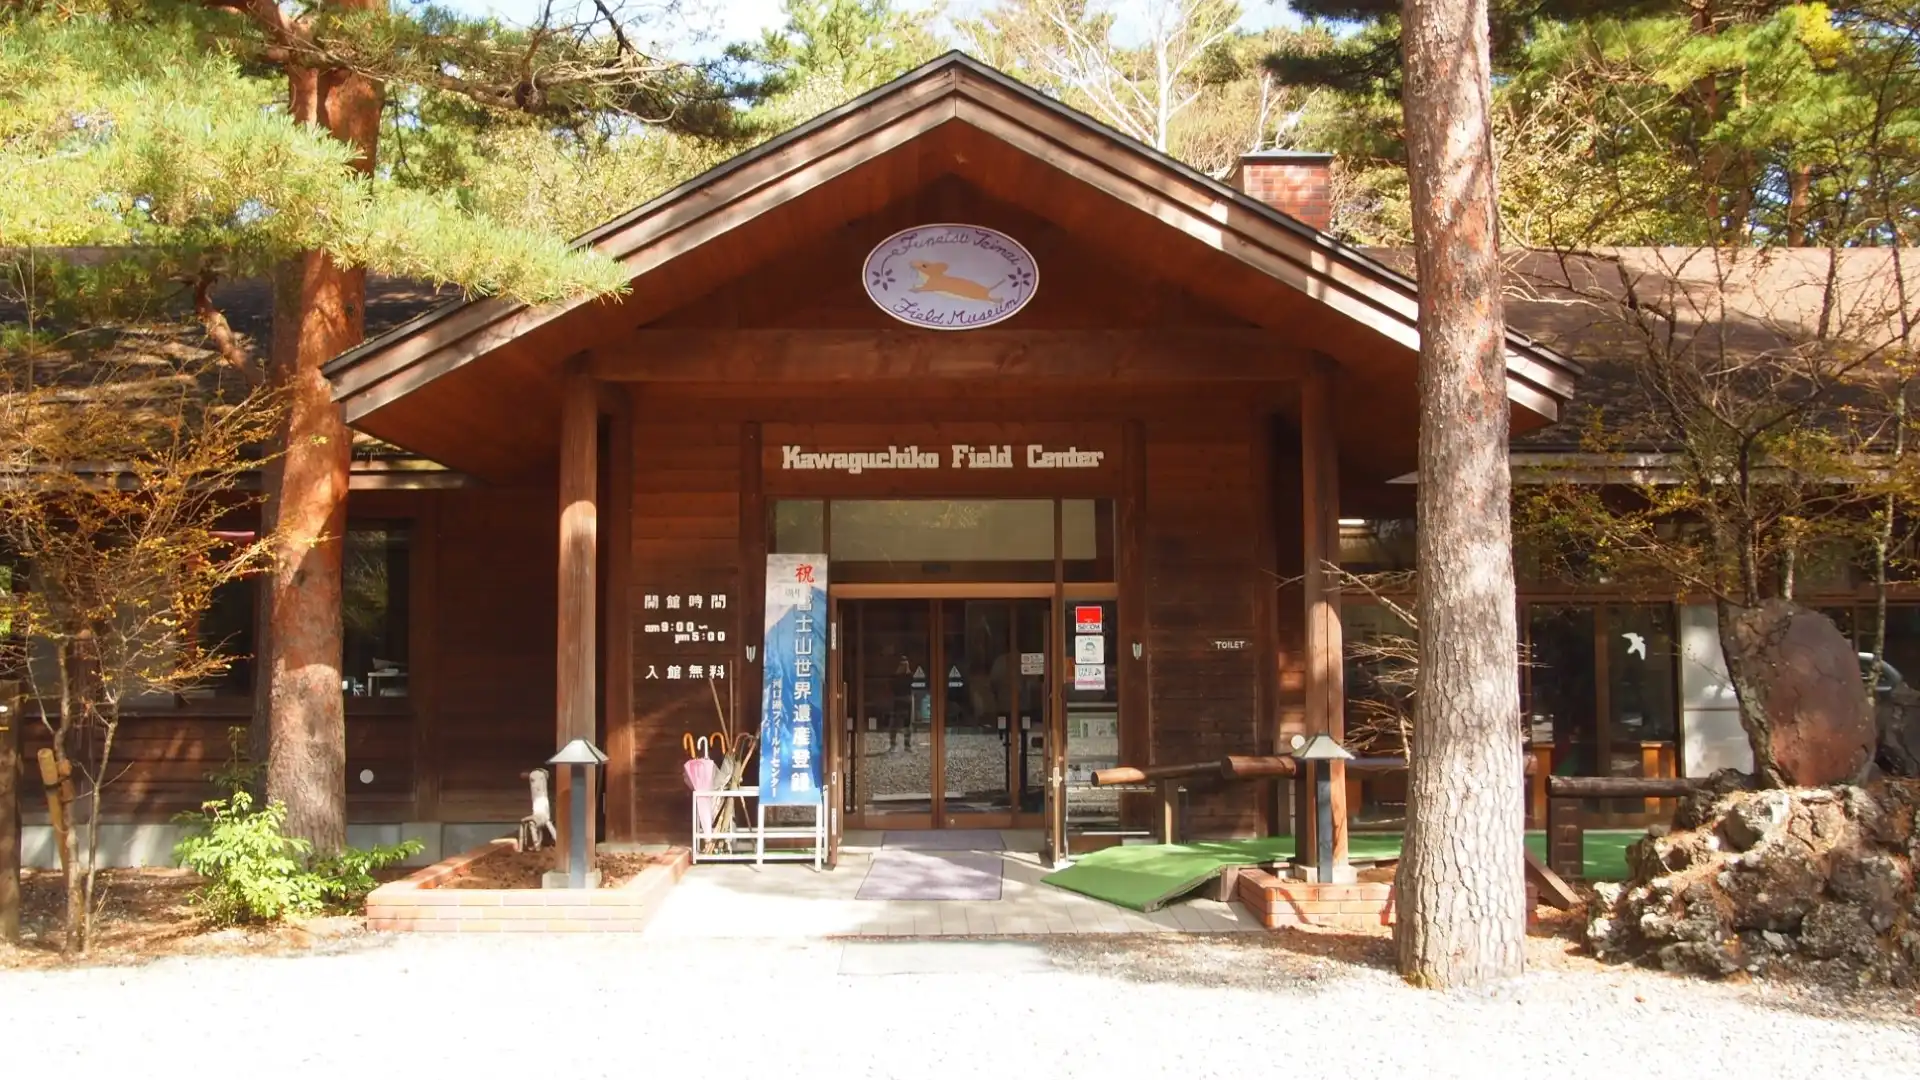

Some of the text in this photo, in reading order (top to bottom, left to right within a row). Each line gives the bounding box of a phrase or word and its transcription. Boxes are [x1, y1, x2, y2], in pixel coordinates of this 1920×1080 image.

[893, 298, 1020, 325] Field Museum
[782, 444, 1104, 474] Kawaguchiko Field Center
[795, 564, 814, 583] 祝
[644, 594, 726, 609] 開館時間
[1214, 640, 1245, 650] TOILET
[645, 664, 725, 679] 入館無料
